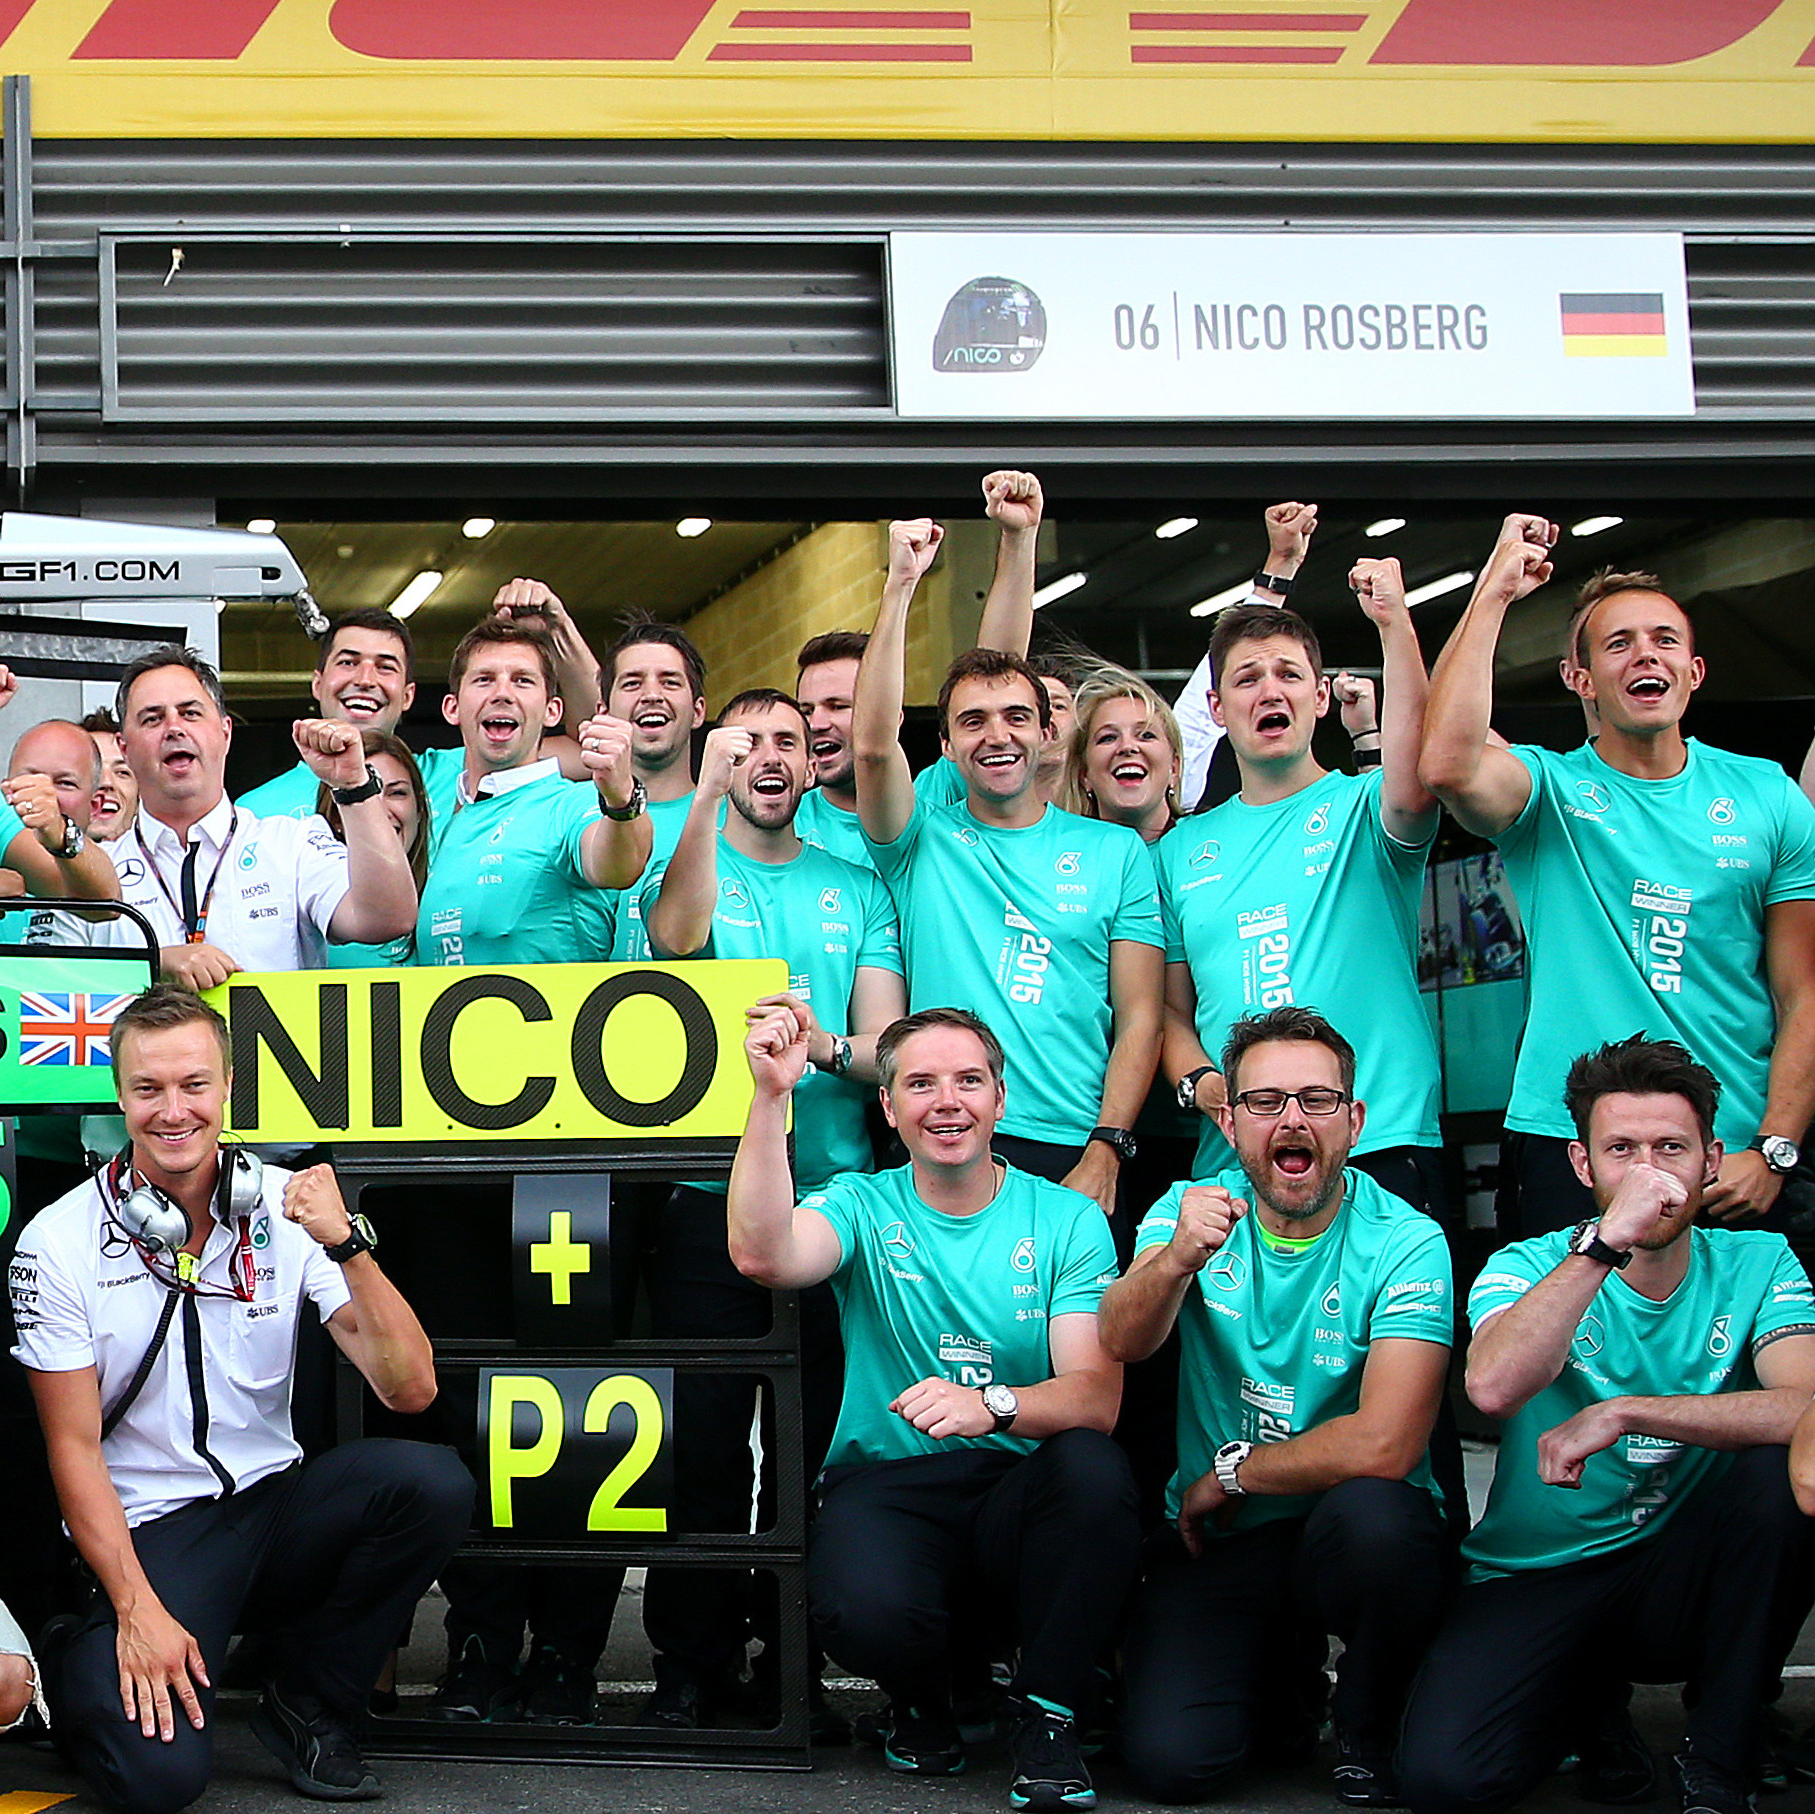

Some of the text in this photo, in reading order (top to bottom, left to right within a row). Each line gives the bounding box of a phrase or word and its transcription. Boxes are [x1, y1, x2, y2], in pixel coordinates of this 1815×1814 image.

[1113, 303, 1488, 351] 06 NICO ROSBERG
[1712, 834, 1748, 846] BOSS
[1729, 858, 1751, 869] UBS
[241, 881, 271, 896] BOSS
[1056, 883, 1088, 895] BOSS
[1633, 878, 1694, 901] RACE
[259, 906, 279, 917] UBS
[1068, 903, 1088, 914] UBS
[1634, 894, 1689, 914] WINNER
[432, 906, 463, 922] RACE
[1237, 902, 1288, 926] RACE
[821, 921, 851, 935] BOSS
[441, 936, 466, 966] 20
[1649, 915, 1688, 995] 2015
[1009, 932, 1052, 1006] 2015
[1259, 933, 1295, 1009] 2015
[788, 973, 811, 987] CE
[228, 969, 718, 1131] NICO
[106, 1271, 151, 1289] BlackBerry
[1386, 1281, 1432, 1300] Allianz
[259, 1304, 279, 1317] UBS
[1203, 1297, 1243, 1320] ackBerry
[939, 1333, 992, 1354] RACE
[941, 1349, 991, 1362] WINNER
[1325, 1355, 1346, 1367] UBS
[1241, 1377, 1296, 1400] RACE
[1242, 1391, 1294, 1413] WINNER
[1258, 1411, 1292, 1443] 20
[1627, 1434, 1685, 1447] RAC
[489, 1374, 668, 1533] P2
